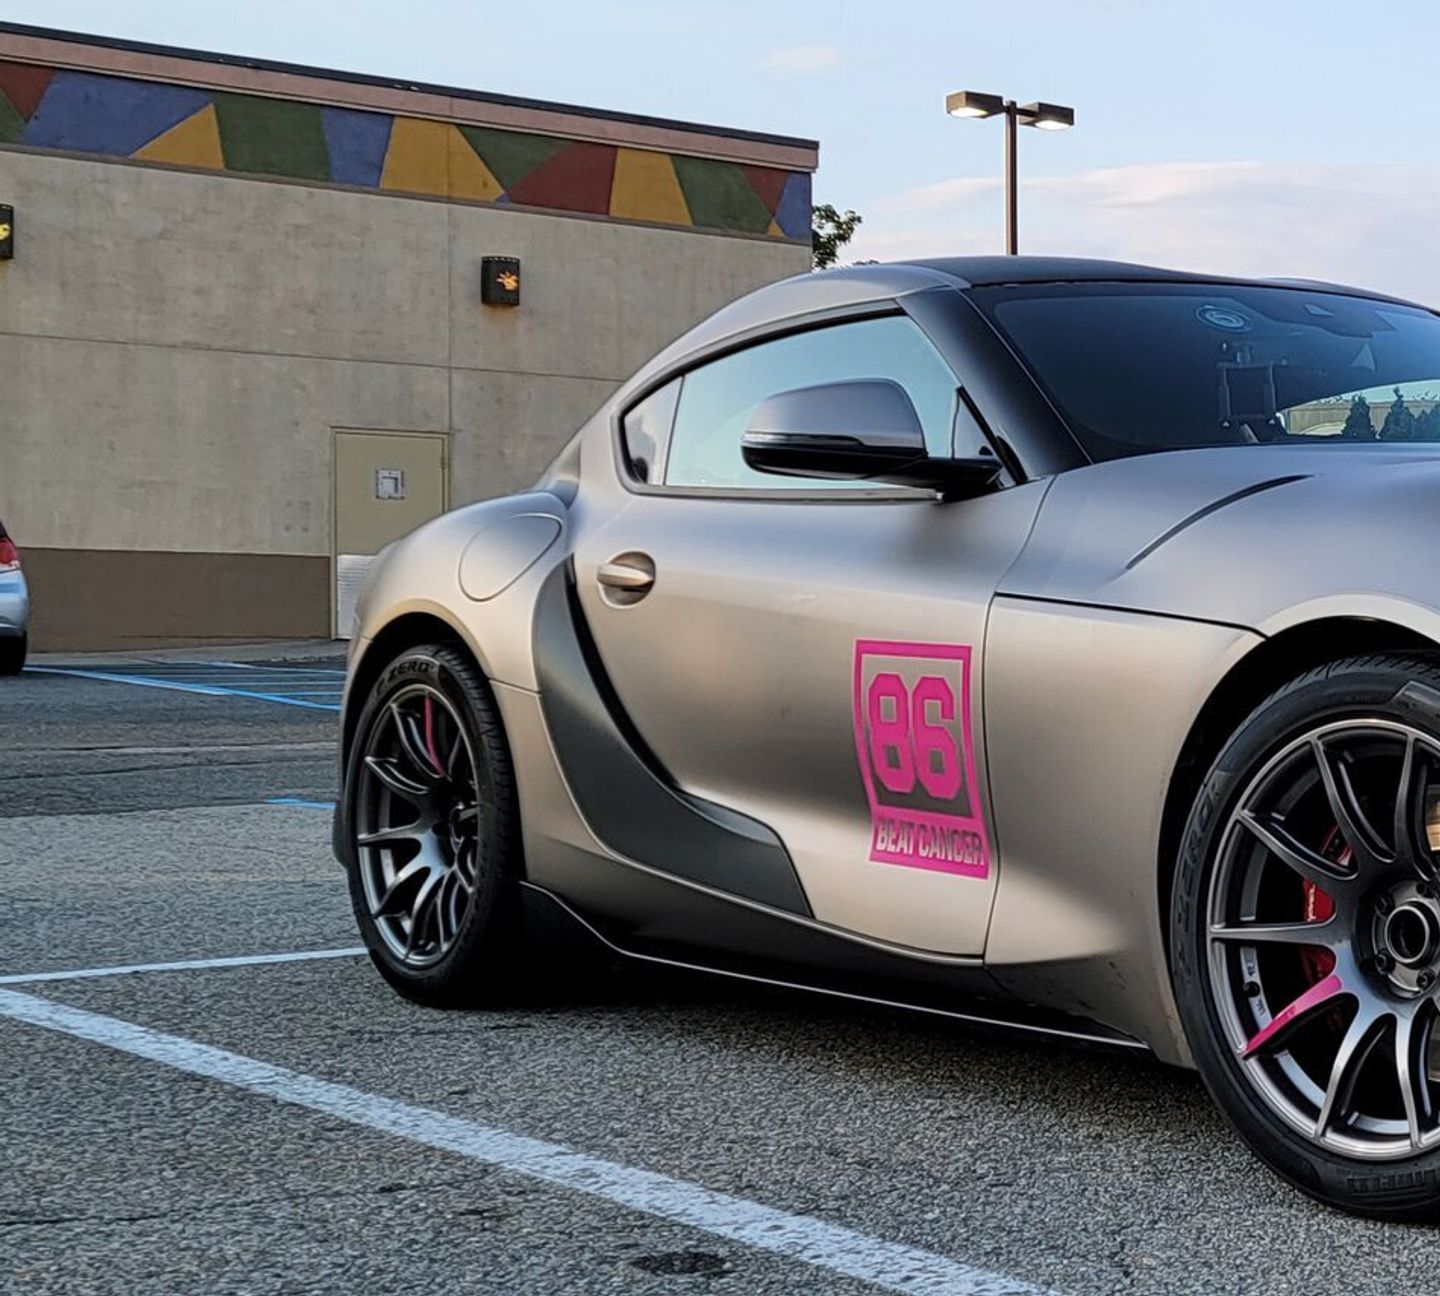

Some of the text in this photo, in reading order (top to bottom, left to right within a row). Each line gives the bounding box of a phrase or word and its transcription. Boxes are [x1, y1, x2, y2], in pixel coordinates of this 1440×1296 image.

[868, 673, 962, 800] 86
[875, 818, 986, 866] BEAT CANCER
